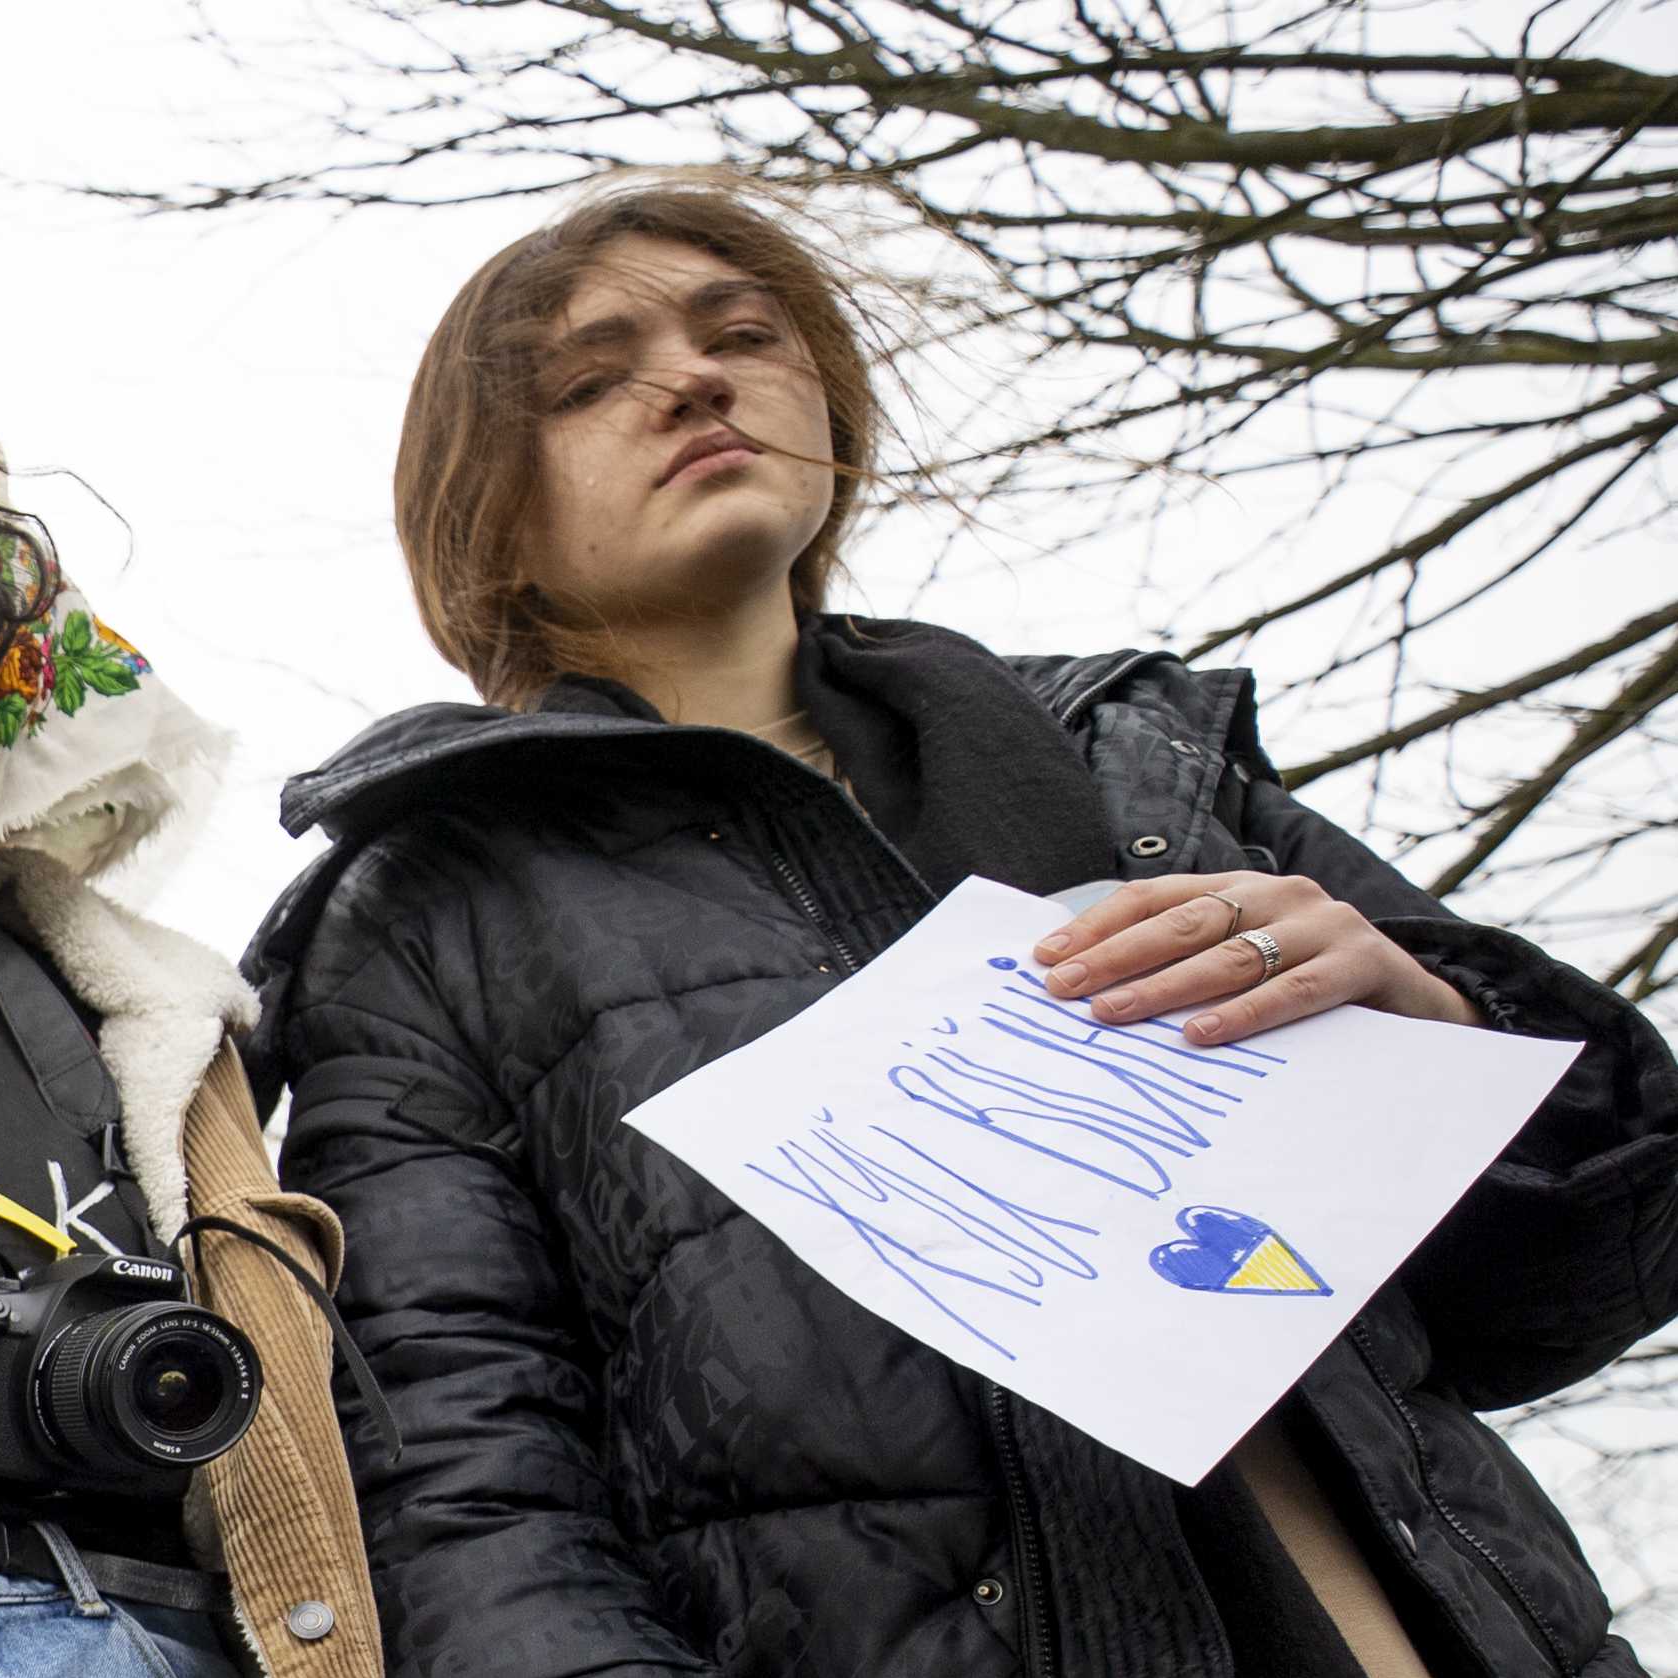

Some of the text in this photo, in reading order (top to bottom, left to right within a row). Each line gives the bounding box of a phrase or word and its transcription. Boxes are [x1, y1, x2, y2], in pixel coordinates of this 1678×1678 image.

[112, 1259, 173, 1282] Canon
[118, 1344, 137, 1371] CANON
[136, 1325, 158, 1344] ZOOM
[160, 1319, 179, 1330] LENS
